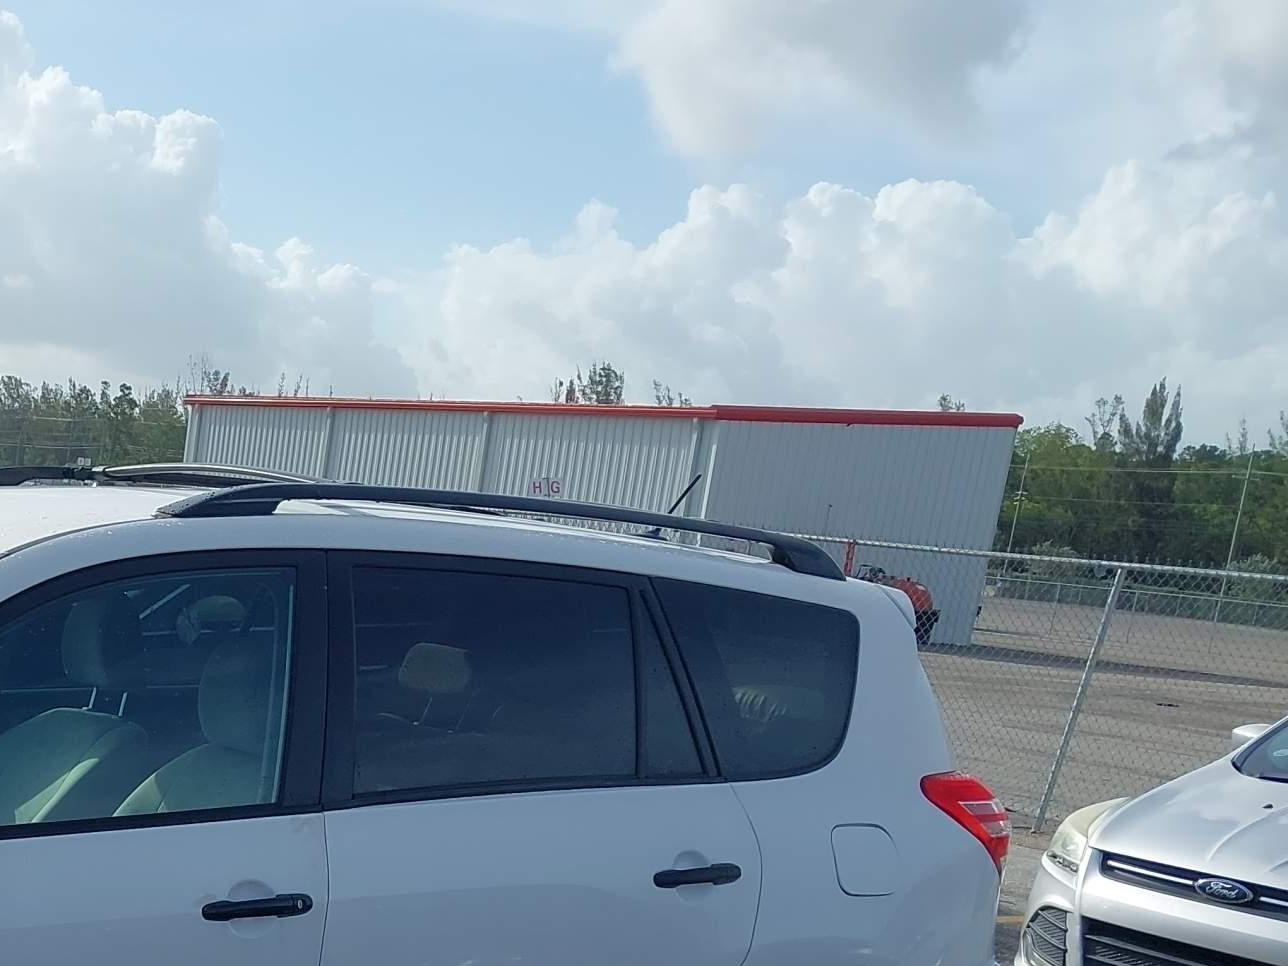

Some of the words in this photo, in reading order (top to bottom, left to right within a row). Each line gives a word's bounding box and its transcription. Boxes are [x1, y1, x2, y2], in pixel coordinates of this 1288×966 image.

[533, 481, 542, 494] H
[551, 481, 561, 494] G
[1206, 882, 1239, 898] Ford
